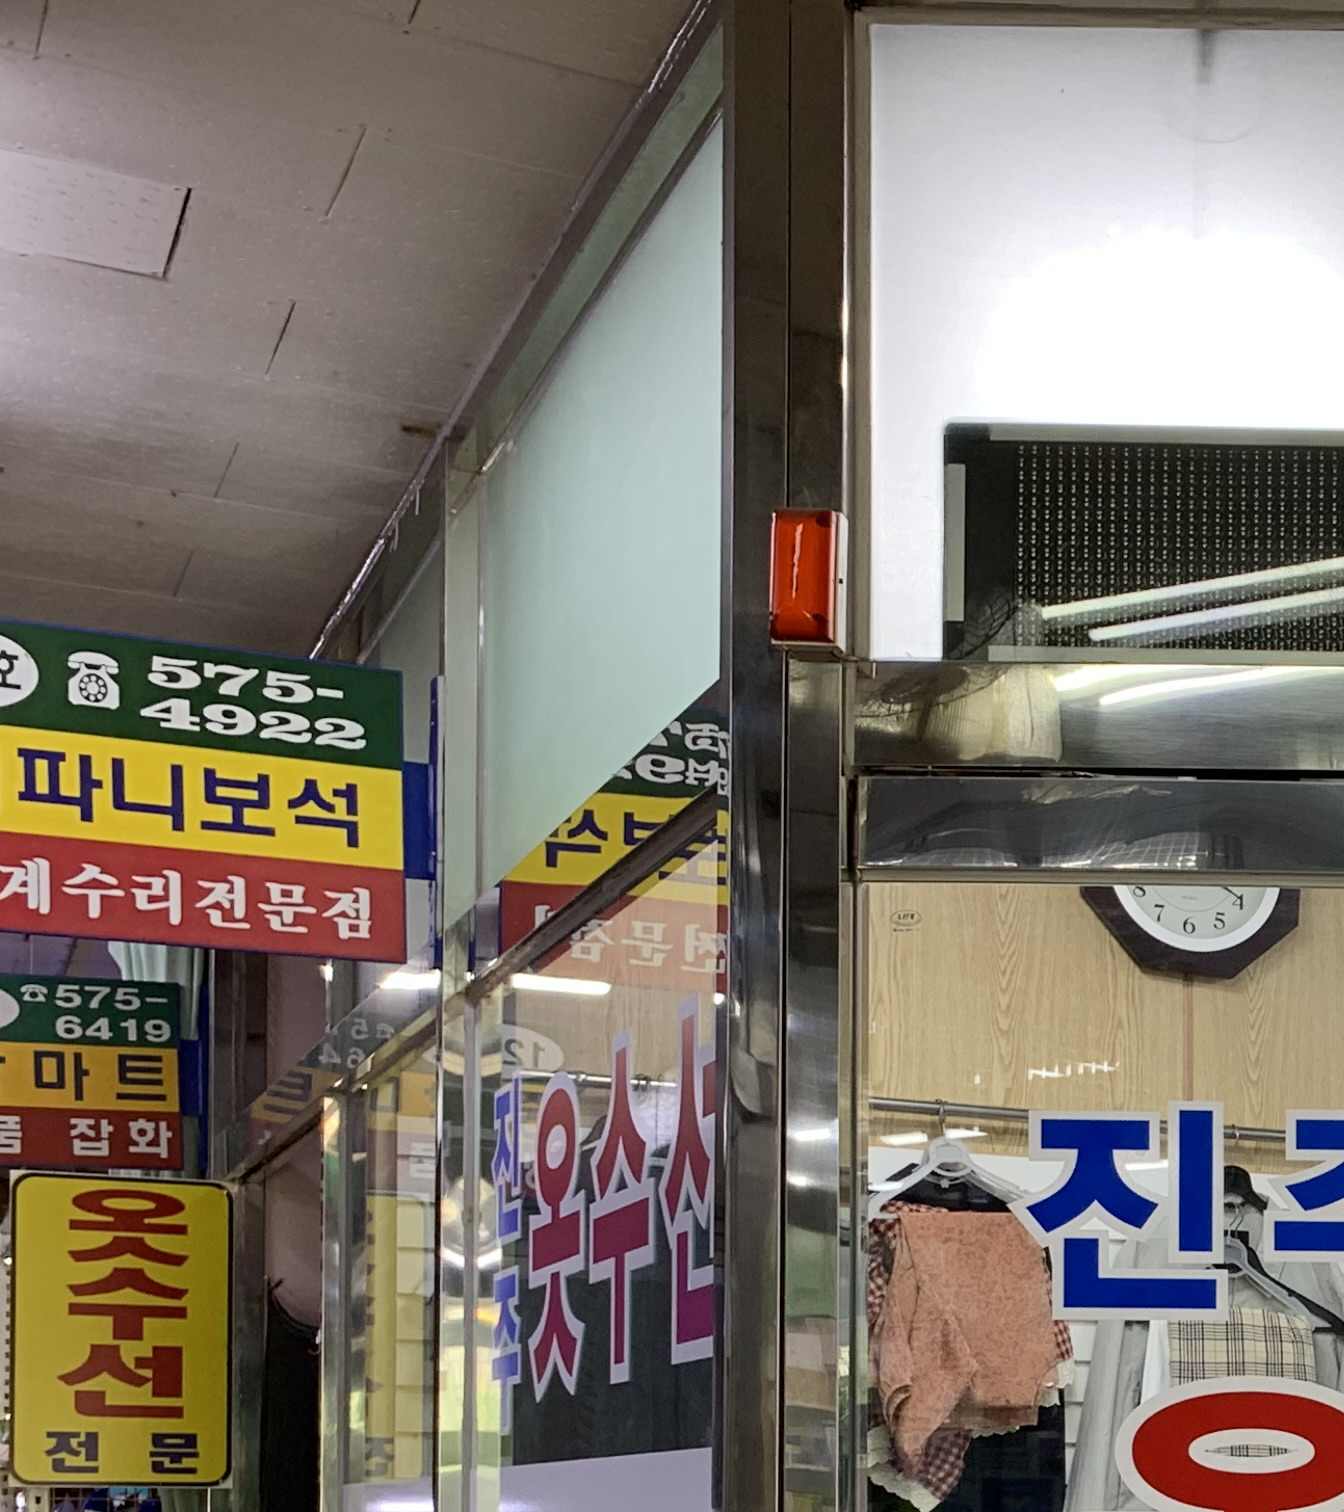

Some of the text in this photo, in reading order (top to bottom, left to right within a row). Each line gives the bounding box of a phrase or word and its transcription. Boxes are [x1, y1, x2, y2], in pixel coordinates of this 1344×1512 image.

[147, 655, 344, 704] 575-
[139, 697, 367, 750] 4922
[17, 746, 360, 849] 파니보석
[1153, 904, 1166, 922] 7
[1182, 916, 1196, 934] 6
[1213, 911, 1227, 930] 5
[54, 984, 169, 1012] 575-
[54, 1015, 172, 1043] 6419
[0, 1049, 168, 1102] 마트
[69, 1117, 174, 1159] 잡화
[56, 1188, 189, 1420] 옷수선
[45, 1431, 200, 1475] 전문
